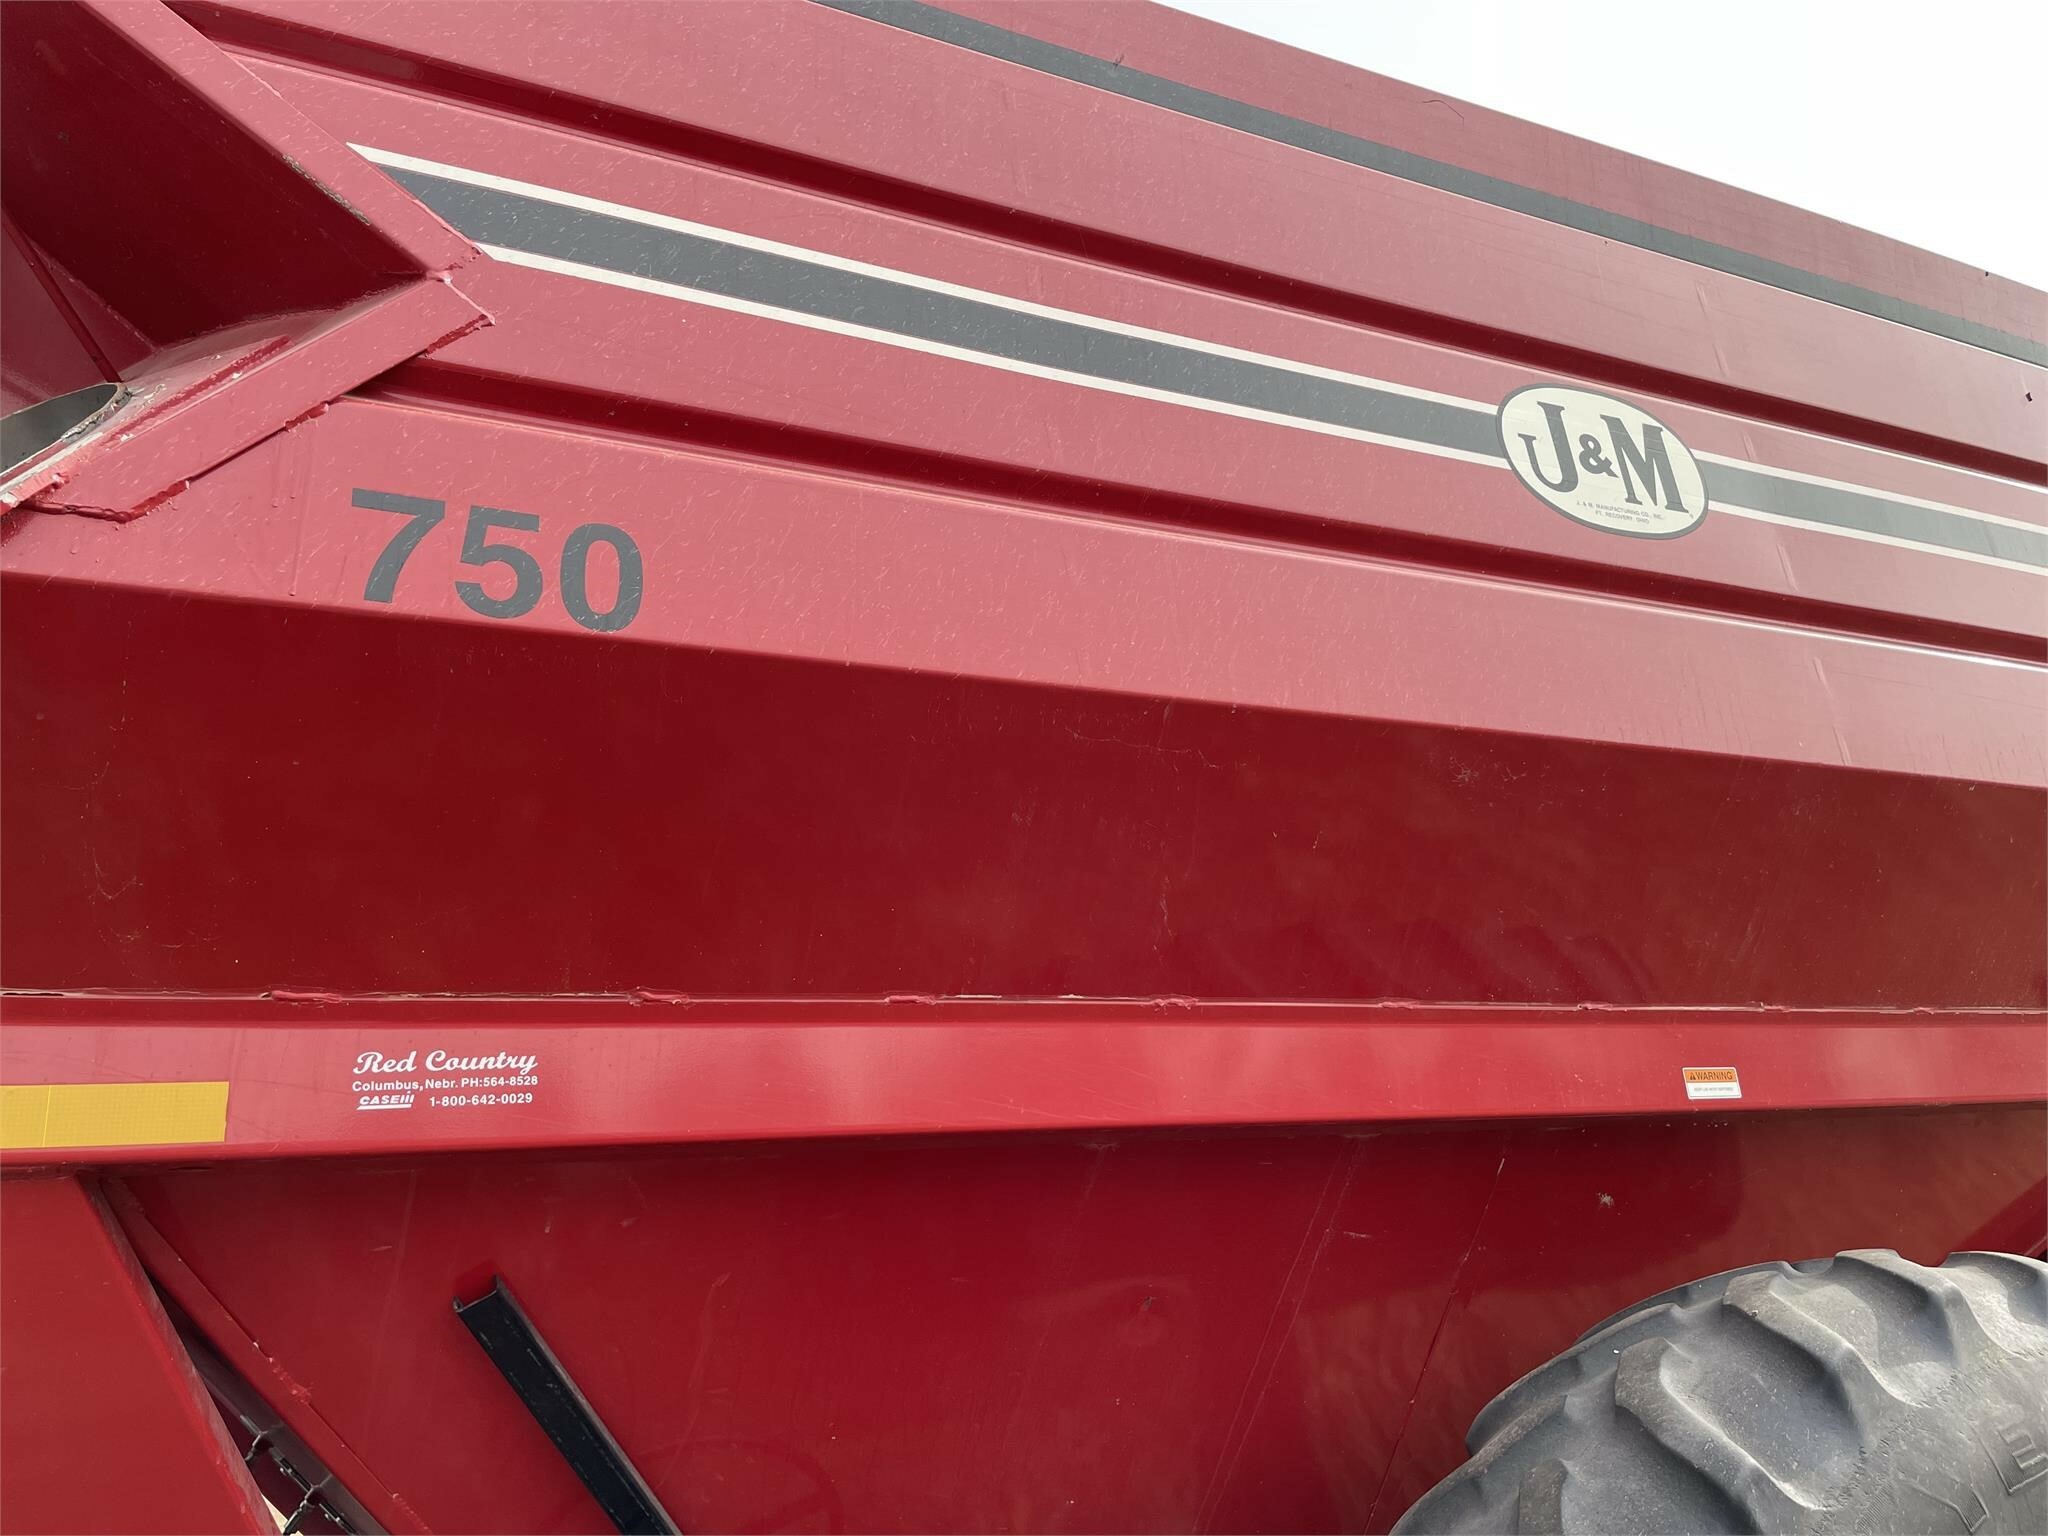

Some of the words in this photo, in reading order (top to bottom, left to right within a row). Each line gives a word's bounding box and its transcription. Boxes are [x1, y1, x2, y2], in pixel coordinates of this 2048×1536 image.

[1518, 401, 1690, 514] J&M
[1595, 503, 1640, 517] MANUFACTURING
[1635, 516, 1650, 524] OHIO
[351, 488, 644, 632] 750
[353, 1051, 417, 1075] Red
[425, 1050, 538, 1075] Country
[352, 1080, 424, 1092] Columbus,
[425, 1078, 459, 1089] Nebr.
[461, 1075, 538, 1088] PH:564-8528
[1695, 1071, 1733, 1081] WARNING
[429, 1092, 533, 1107] 1-800-642-0029
